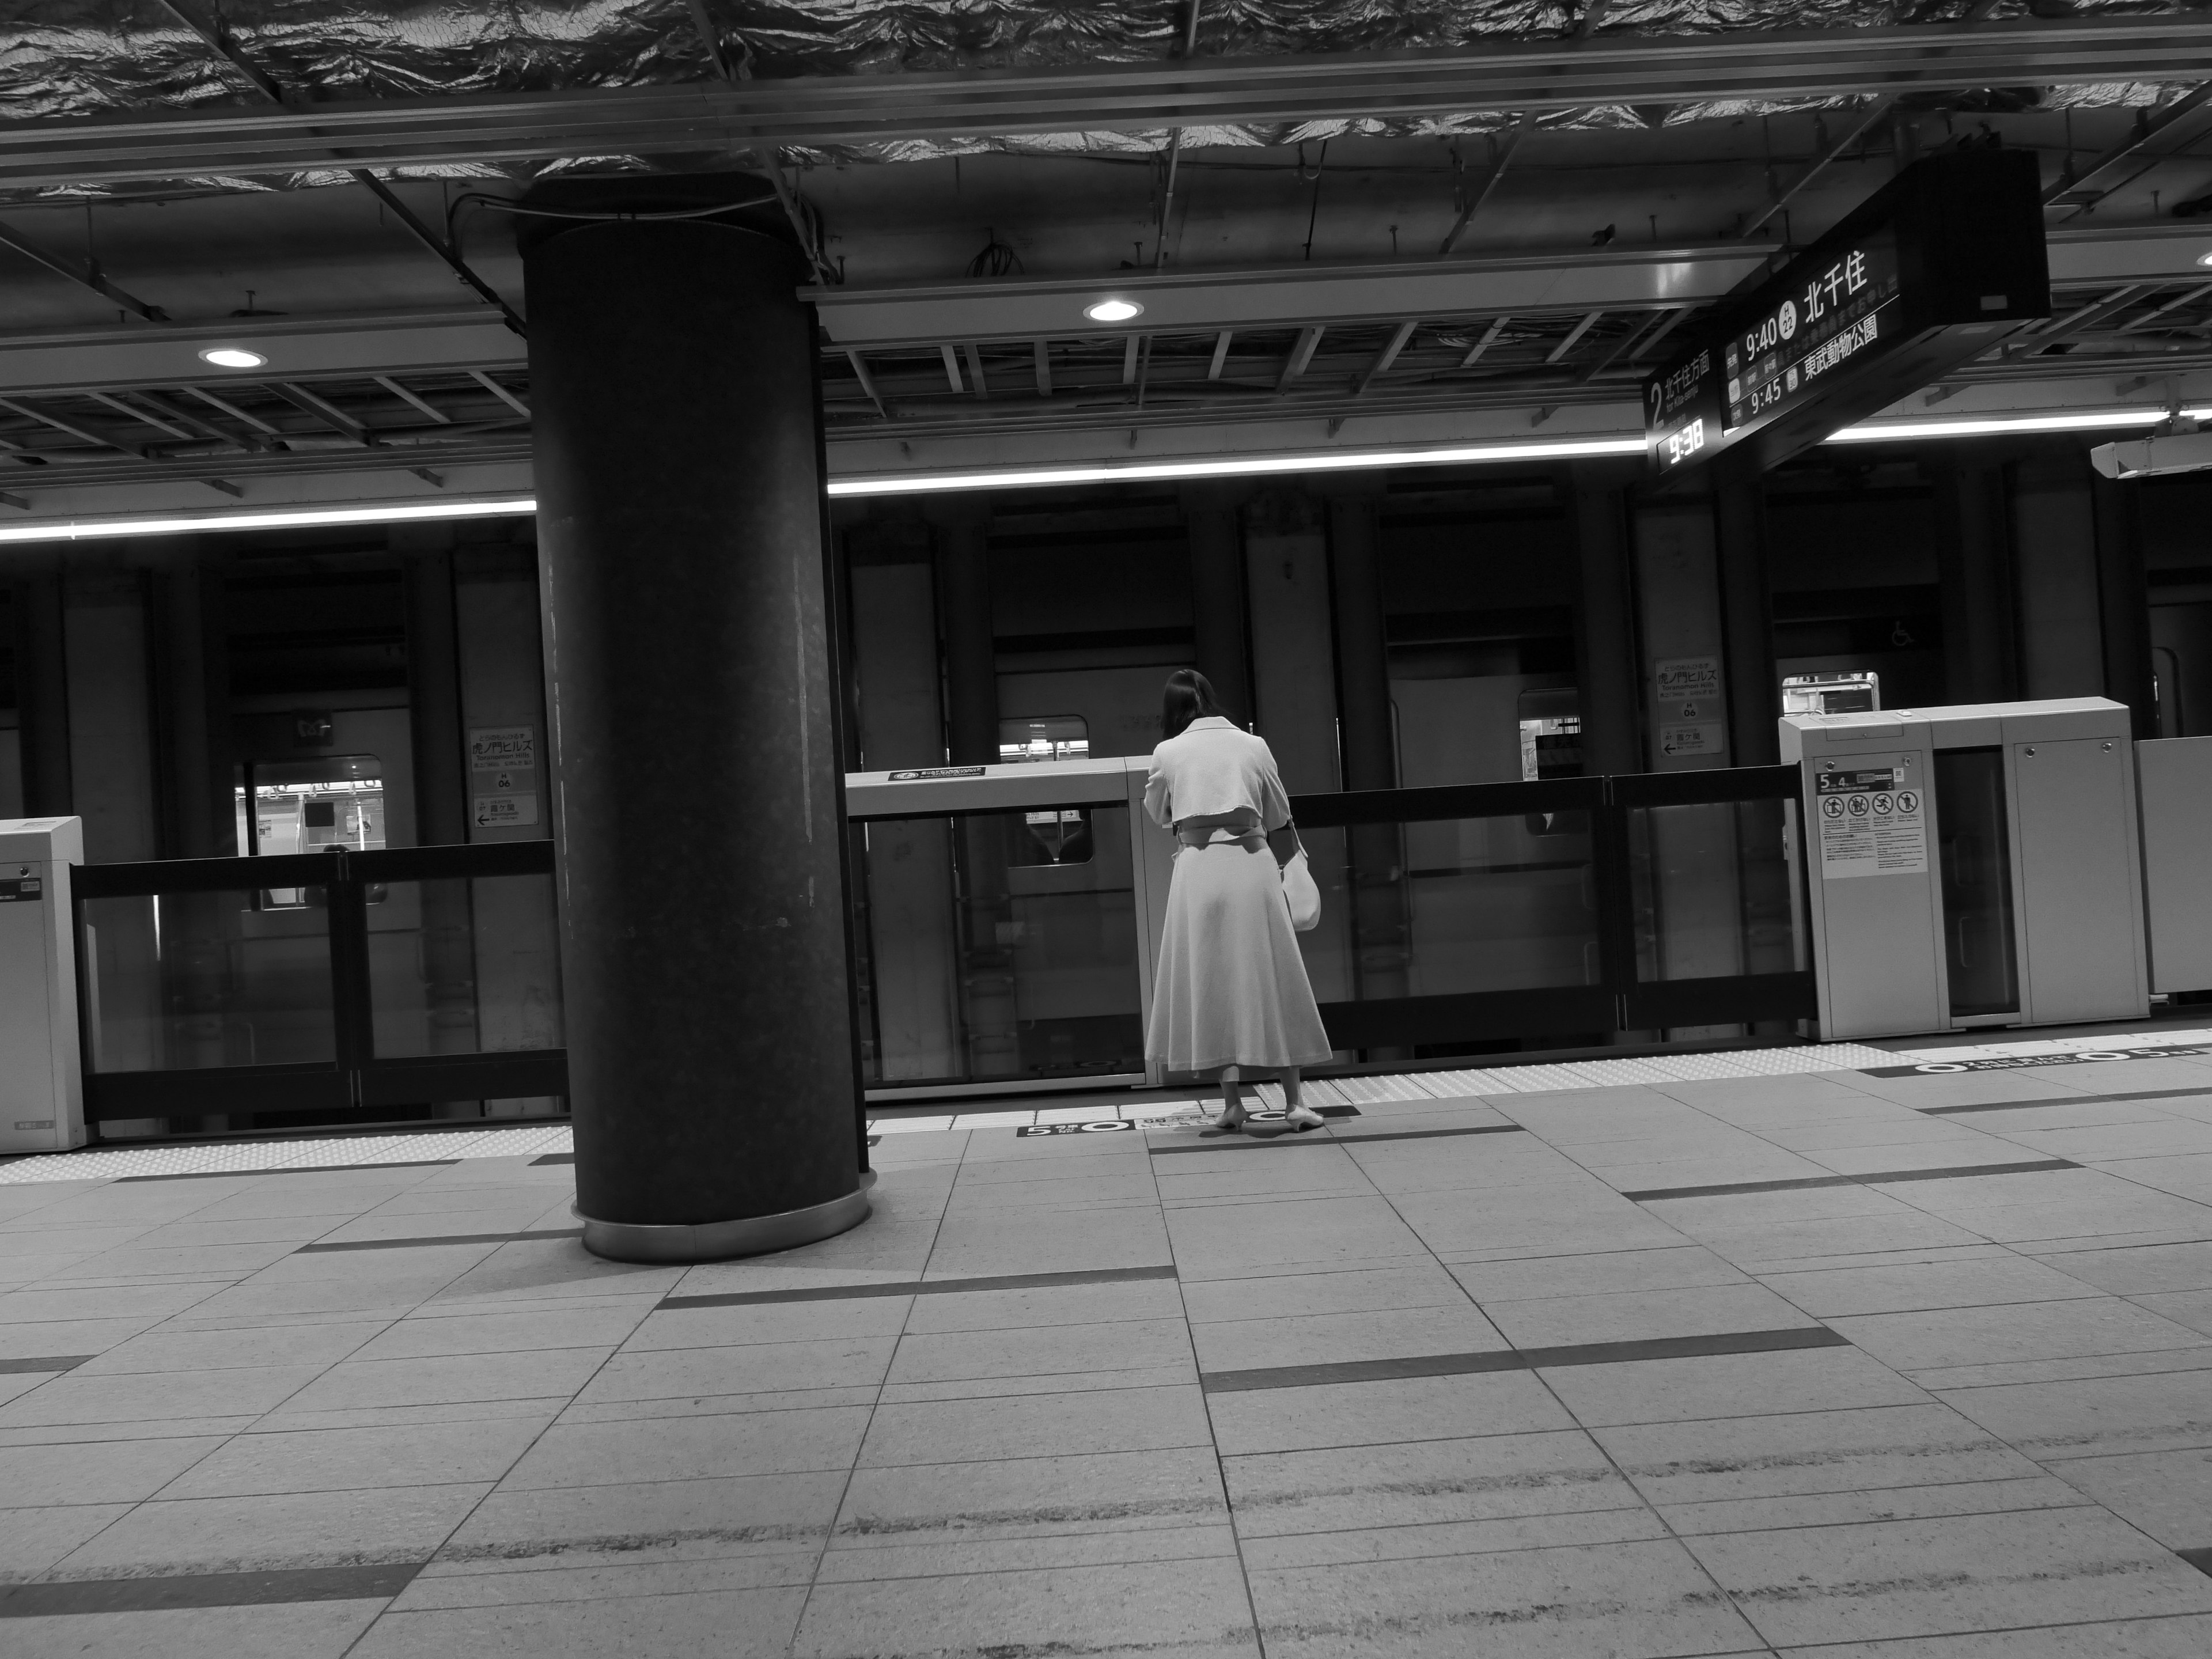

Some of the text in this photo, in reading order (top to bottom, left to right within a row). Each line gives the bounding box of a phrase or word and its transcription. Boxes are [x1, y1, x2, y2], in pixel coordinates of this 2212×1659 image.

[1747, 317, 1778, 361] 9:40
[1804, 250, 1868, 324] 北千住
[1784, 305, 1790, 317] H
[1783, 316, 1793, 334] 22
[1751, 377, 1781, 414] 9:45
[1804, 314, 1878, 381] 東武動物公園
[1650, 382, 1664, 431] 2
[1664, 349, 1710, 400] 北千住方面
[1670, 418, 1705, 464] 9:38
[1658, 669, 1717, 685] 虎ノ門ヒルズ
[1684, 709, 1696, 717] 06
[472, 740, 533, 755] 虎ノ門ヒルズ
[1820, 774, 1830, 789] 5
[1838, 777, 1846, 787] 4
[2127, 1048, 2170, 1058] 5
[1027, 1126, 1052, 1136] 5
